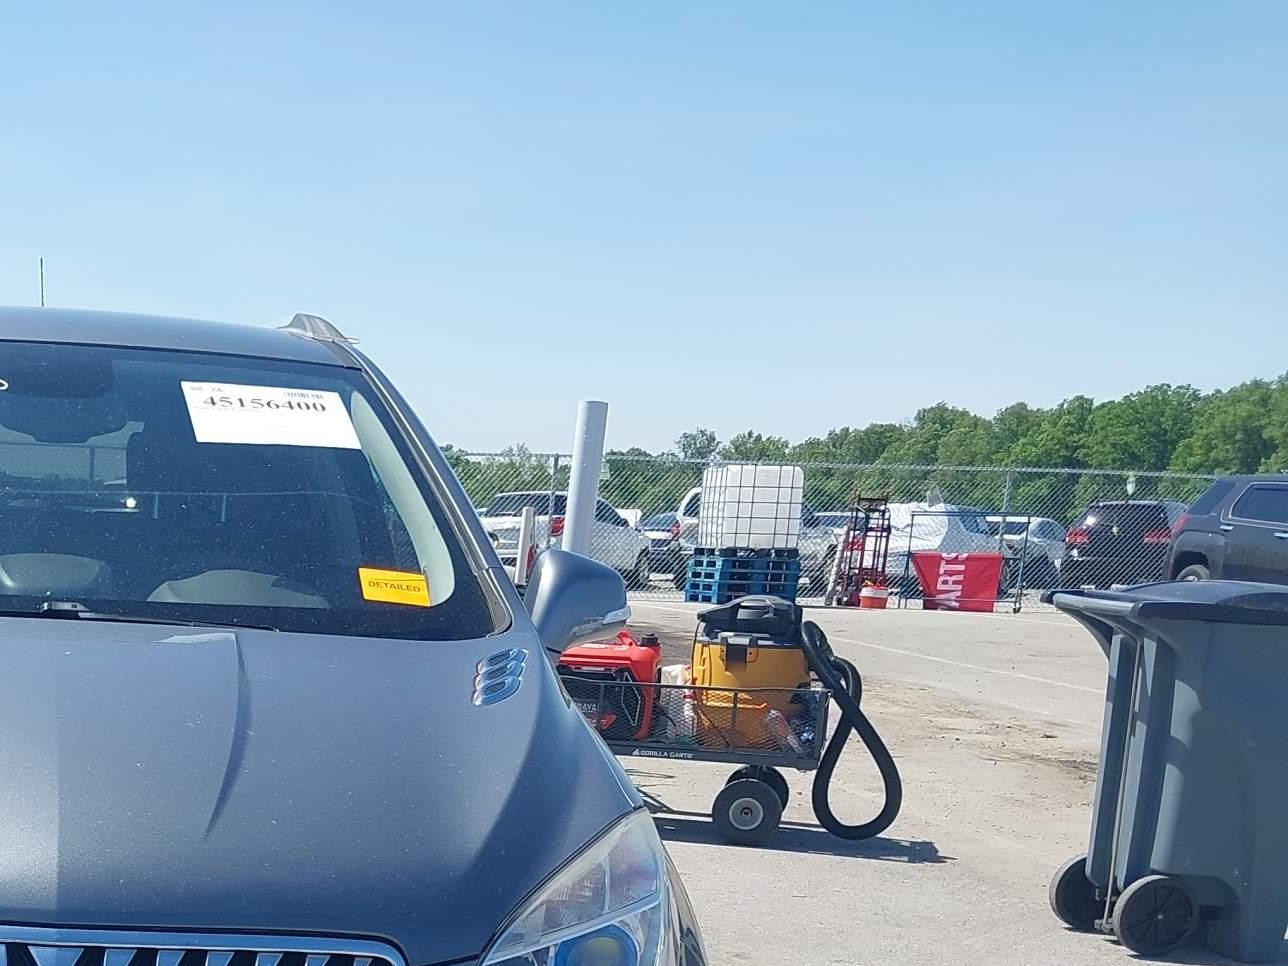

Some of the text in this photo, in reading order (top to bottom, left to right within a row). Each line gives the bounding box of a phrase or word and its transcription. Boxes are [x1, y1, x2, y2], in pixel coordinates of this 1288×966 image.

[202, 395, 327, 413] 45156400
[368, 581, 421, 593] DETAILED
[935, 552, 969, 609] ARTS
